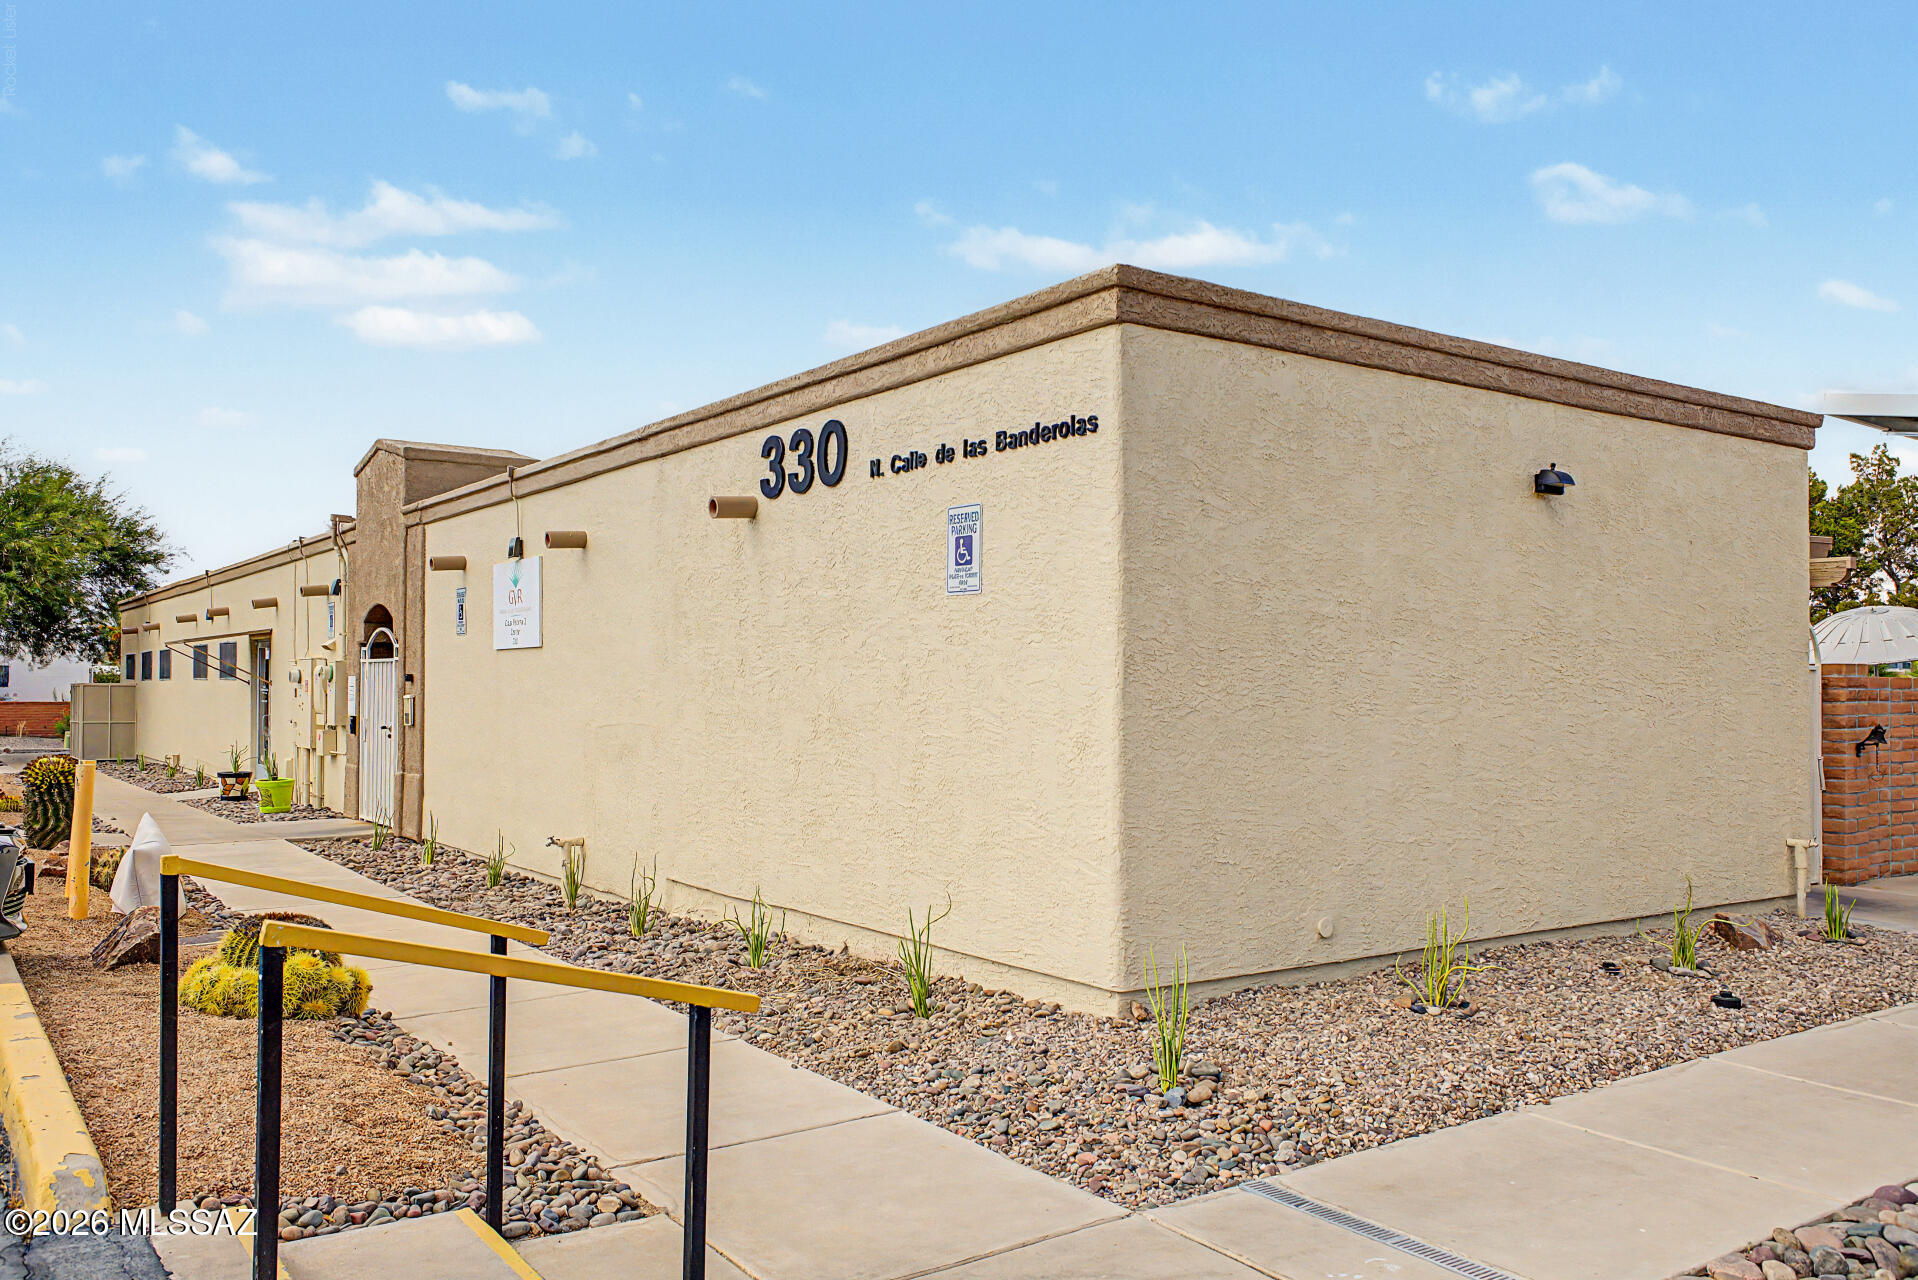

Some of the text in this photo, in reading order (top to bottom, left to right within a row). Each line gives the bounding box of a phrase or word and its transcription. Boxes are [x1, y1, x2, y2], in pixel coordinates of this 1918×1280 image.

[760, 414, 1099, 500] 330 N. Calle de las Banderolas
[949, 511, 979, 525] RESERVED
[952, 523, 977, 535] PARKING
